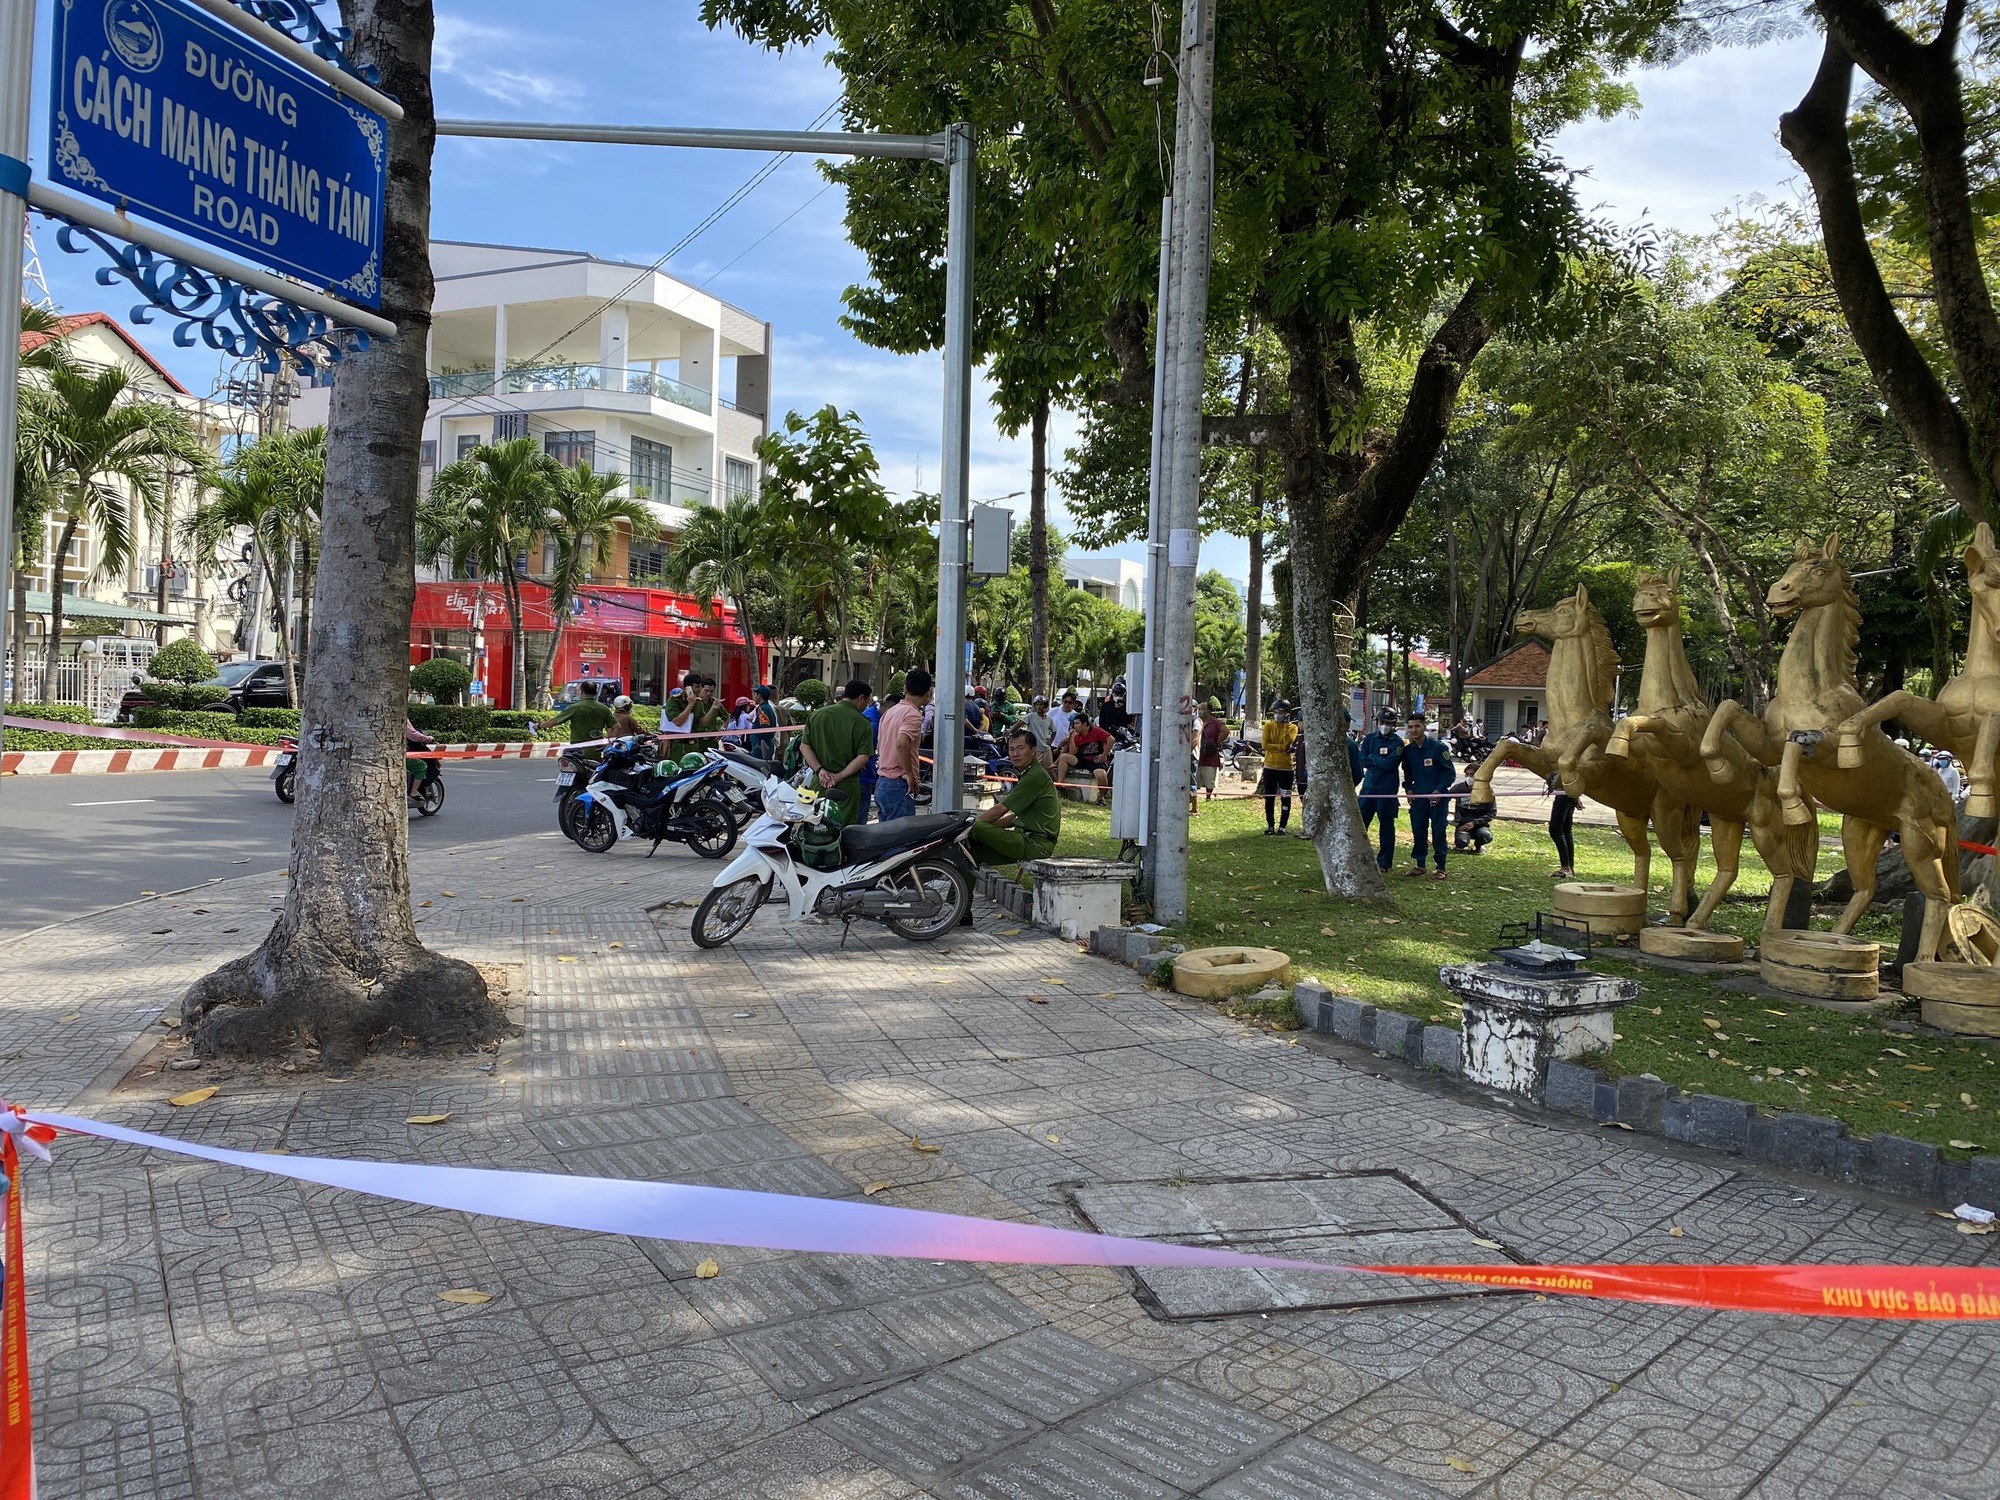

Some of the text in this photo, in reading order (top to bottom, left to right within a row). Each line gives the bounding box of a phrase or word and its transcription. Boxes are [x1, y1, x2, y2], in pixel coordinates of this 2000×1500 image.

[185, 40, 298, 128] ĐƯỜNG
[73, 48, 371, 247] CÁCH MẠNG THÁNG TÁM
[193, 184, 280, 247] ROAD
[1534, 1274, 1594, 1290] THÔNG
[1822, 1287, 1863, 1308] KHU
[1867, 1287, 1910, 1314] VỰC
[1913, 1280, 1957, 1314] BẢO
[8, 1402, 21, 1427] KHU
